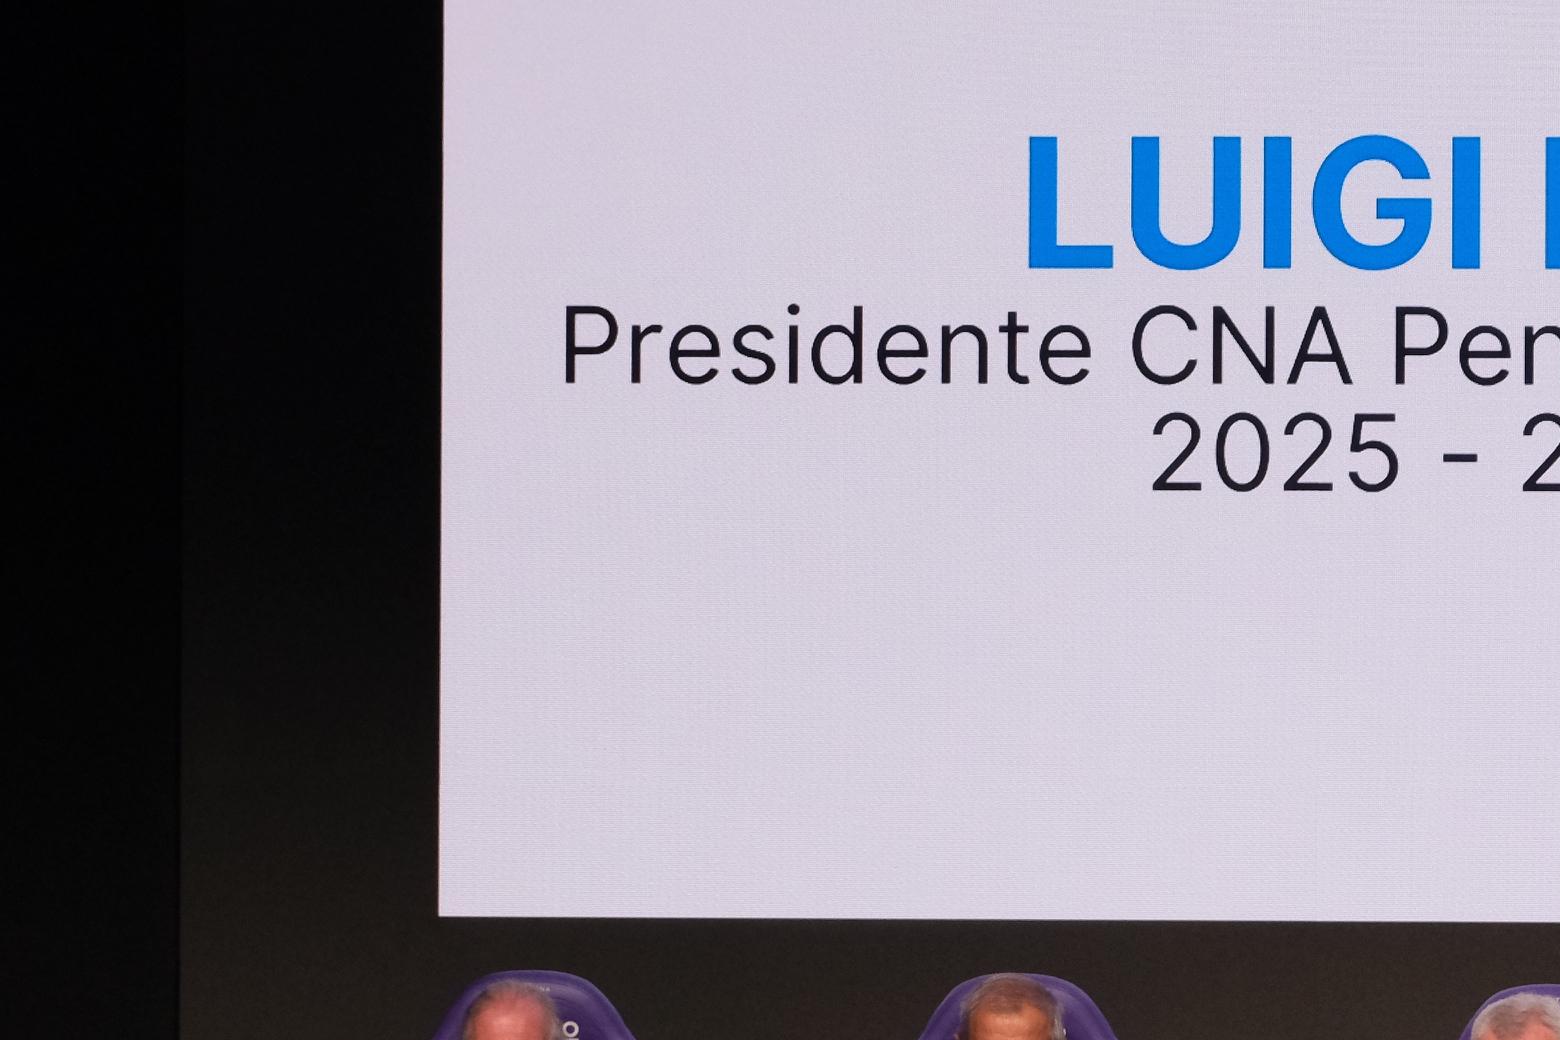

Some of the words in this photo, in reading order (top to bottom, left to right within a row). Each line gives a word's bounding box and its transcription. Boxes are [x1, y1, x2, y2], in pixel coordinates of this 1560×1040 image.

[1028, 135, 1481, 271] LUIGI
[566, 304, 1091, 385] Presidente
[1132, 305, 1352, 385] CNA
[1153, 412, 1398, 492] 2025
[1443, 453, 1477, 463] -
